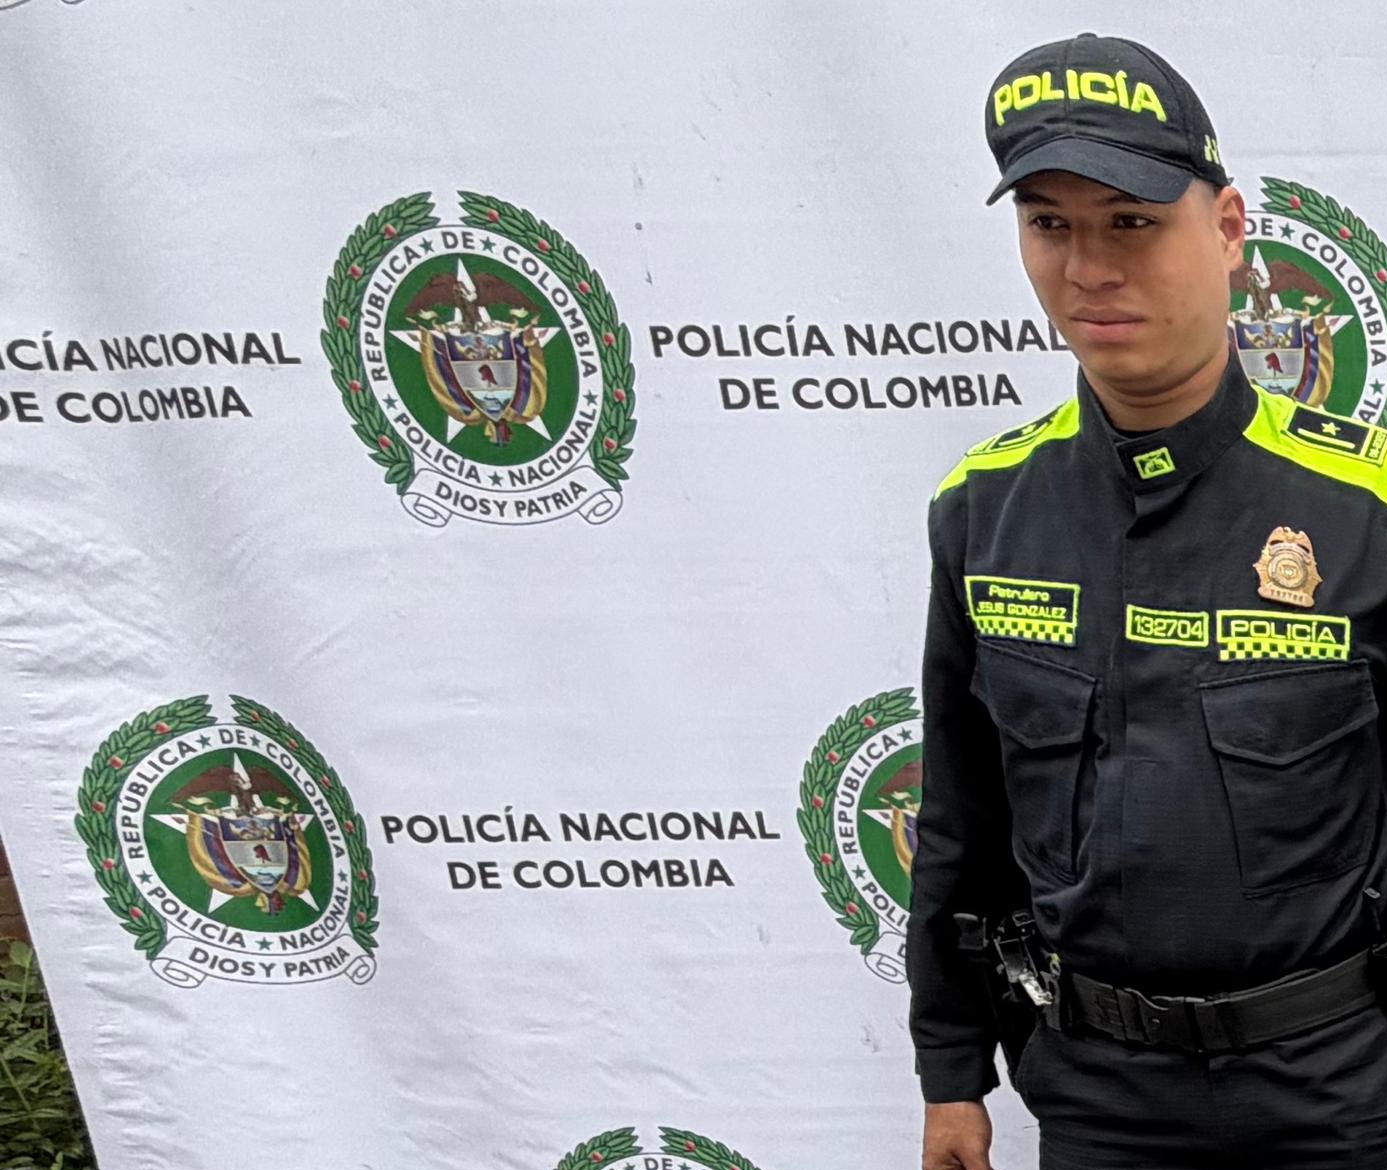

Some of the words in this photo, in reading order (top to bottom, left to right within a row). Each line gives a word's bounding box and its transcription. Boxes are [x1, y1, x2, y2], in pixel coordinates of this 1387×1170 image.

[994, 69, 1167, 126] POLICÍA
[442, 231, 475, 250] DE
[503, 245, 597, 378] COLOMBIA
[1303, 233, 1387, 366] COLOMBIA
[100, 333, 301, 370] NACIONAL
[650, 316, 834, 357] POLICÍA
[846, 319, 1071, 356] NACIONAL
[57, 386, 252, 423] COLOMBIA
[719, 379, 779, 409] DE
[793, 374, 1022, 409] COLOMBIA
[394, 413, 482, 483] POLICÍA
[508, 408, 597, 487] NACIONAL
[435, 481, 490, 514] DIOS
[490, 498, 508, 518] Y
[515, 480, 587, 517] PATRIA
[1134, 615, 1203, 639] 132704
[1230, 620, 1336, 643] POLICÍA
[218, 729, 246, 745] DE
[266, 743, 345, 859] COLOMBIA
[381, 806, 551, 843] POLICÍA
[560, 811, 780, 841] NACIONAL
[447, 862, 502, 889] DE
[513, 859, 734, 888] COLOMBIA
[147, 887, 246, 948] POLICÍA
[278, 884, 348, 951] NACIONAL
[188, 947, 260, 977] DIOS
[260, 962, 276, 978] Y
[283, 946, 350, 977] PATRIA
